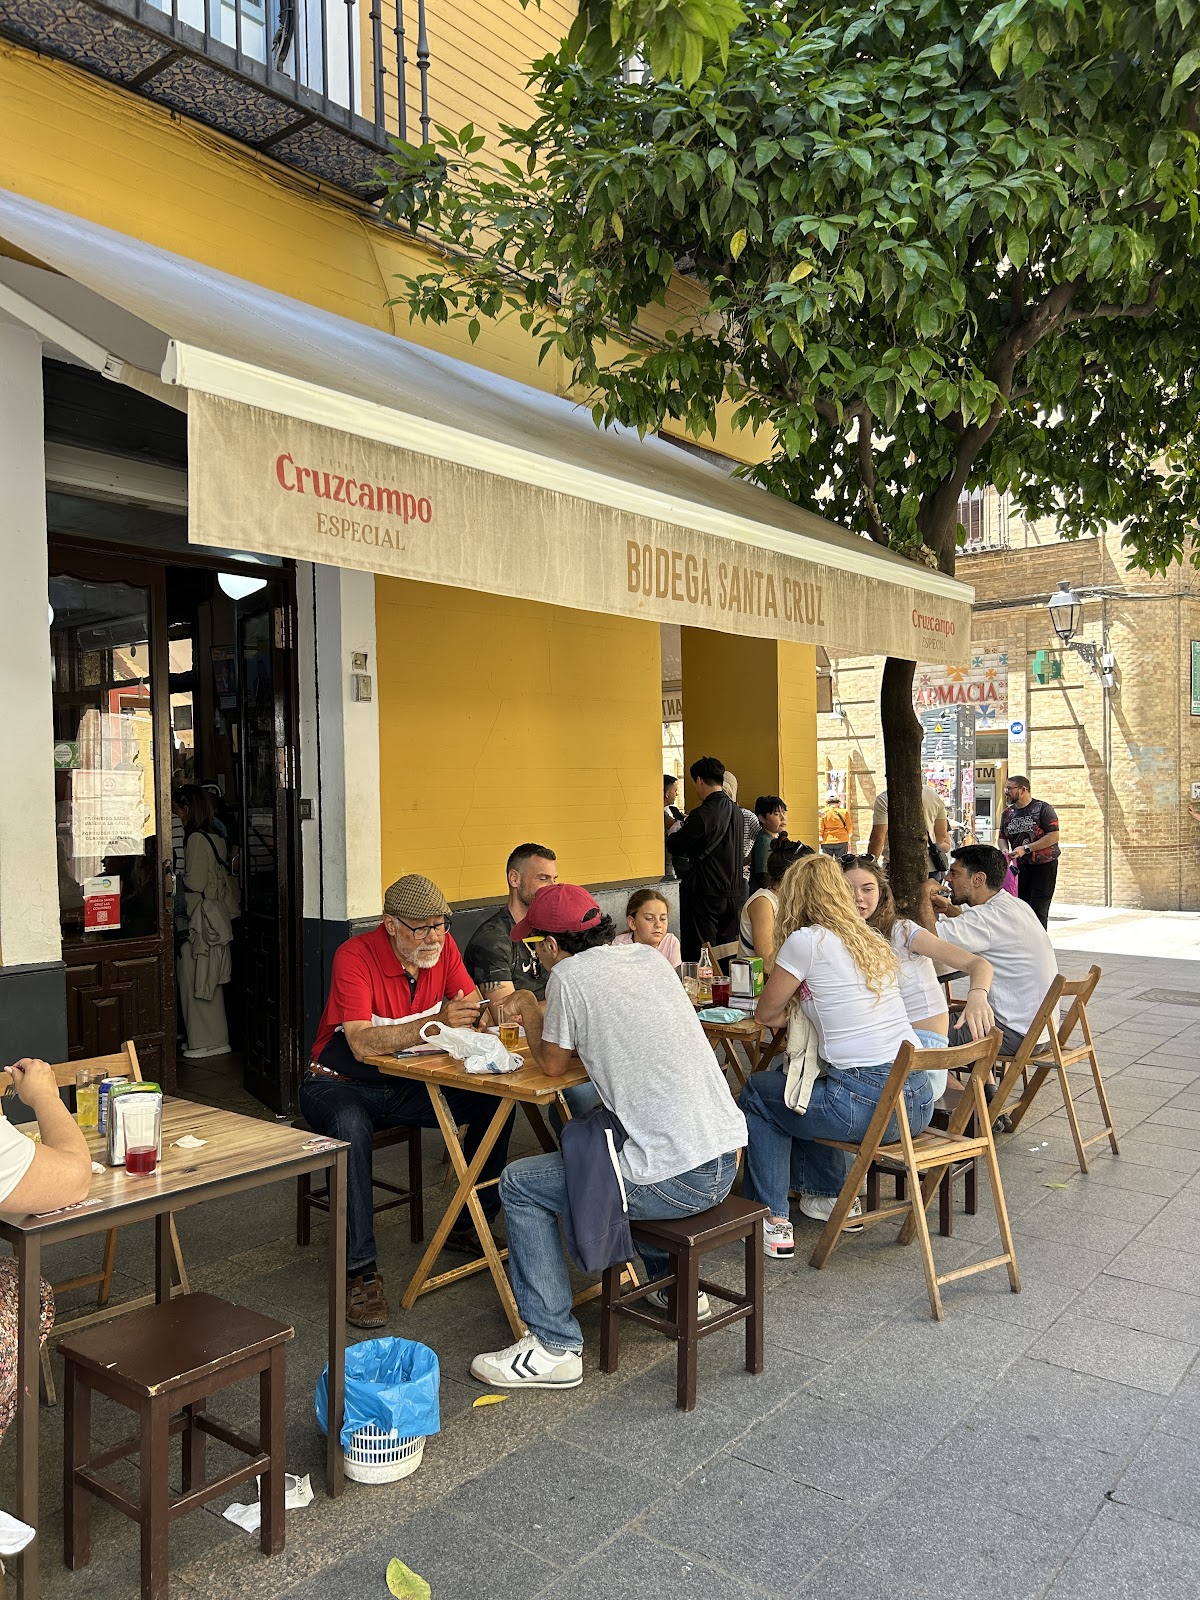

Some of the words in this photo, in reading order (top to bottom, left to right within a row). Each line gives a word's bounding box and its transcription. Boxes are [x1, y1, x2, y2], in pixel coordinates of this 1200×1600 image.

[276, 452, 432, 525] Cruzcampo
[316, 512, 406, 551] ESPECIAL
[626, 540, 712, 607] BODEGA
[719, 562, 778, 618] SANTA
[783, 577, 825, 627] CRUZ
[912, 608, 955, 637] Cruzcampo
[922, 637, 947, 651] ESPECIAL
[912, 681, 998, 707] ARMACIA
[975, 767, 996, 778] TM
